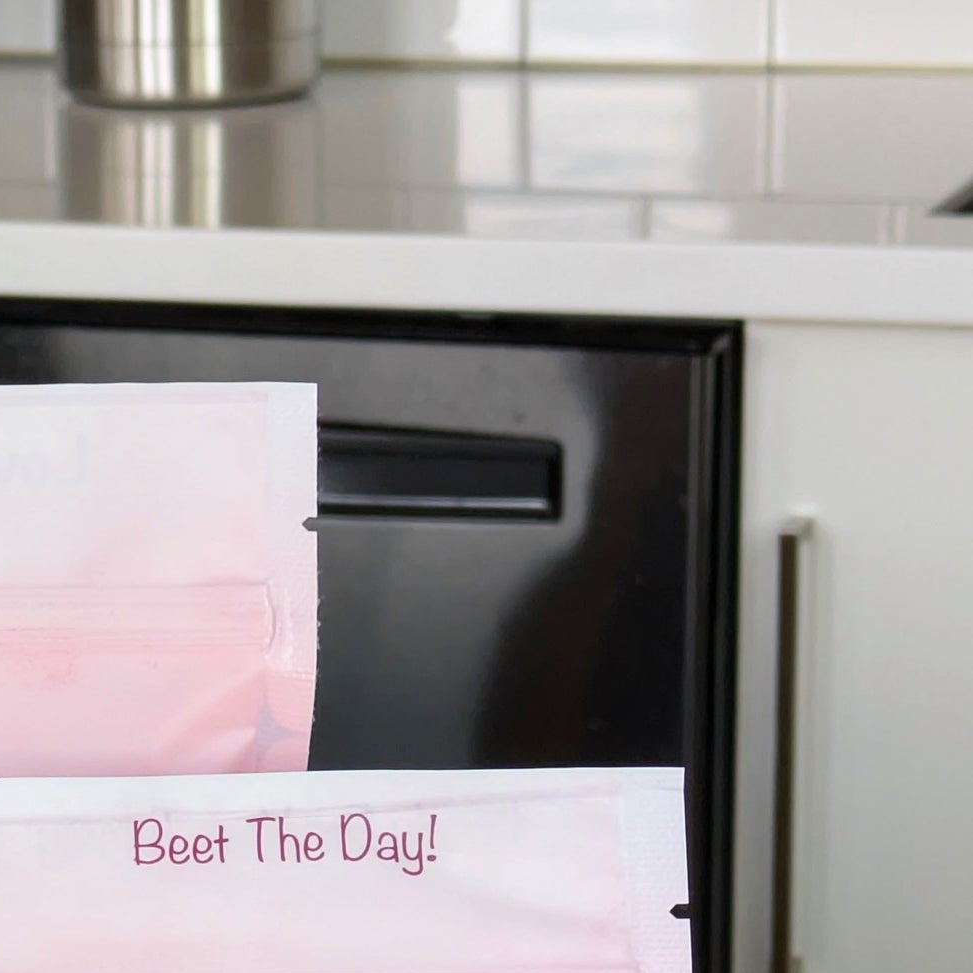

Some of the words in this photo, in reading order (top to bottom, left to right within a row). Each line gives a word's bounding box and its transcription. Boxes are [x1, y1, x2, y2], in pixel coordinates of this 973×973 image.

[133, 818, 229, 866] Beet
[245, 816, 325, 863] The
[340, 813, 437, 876] Day!
